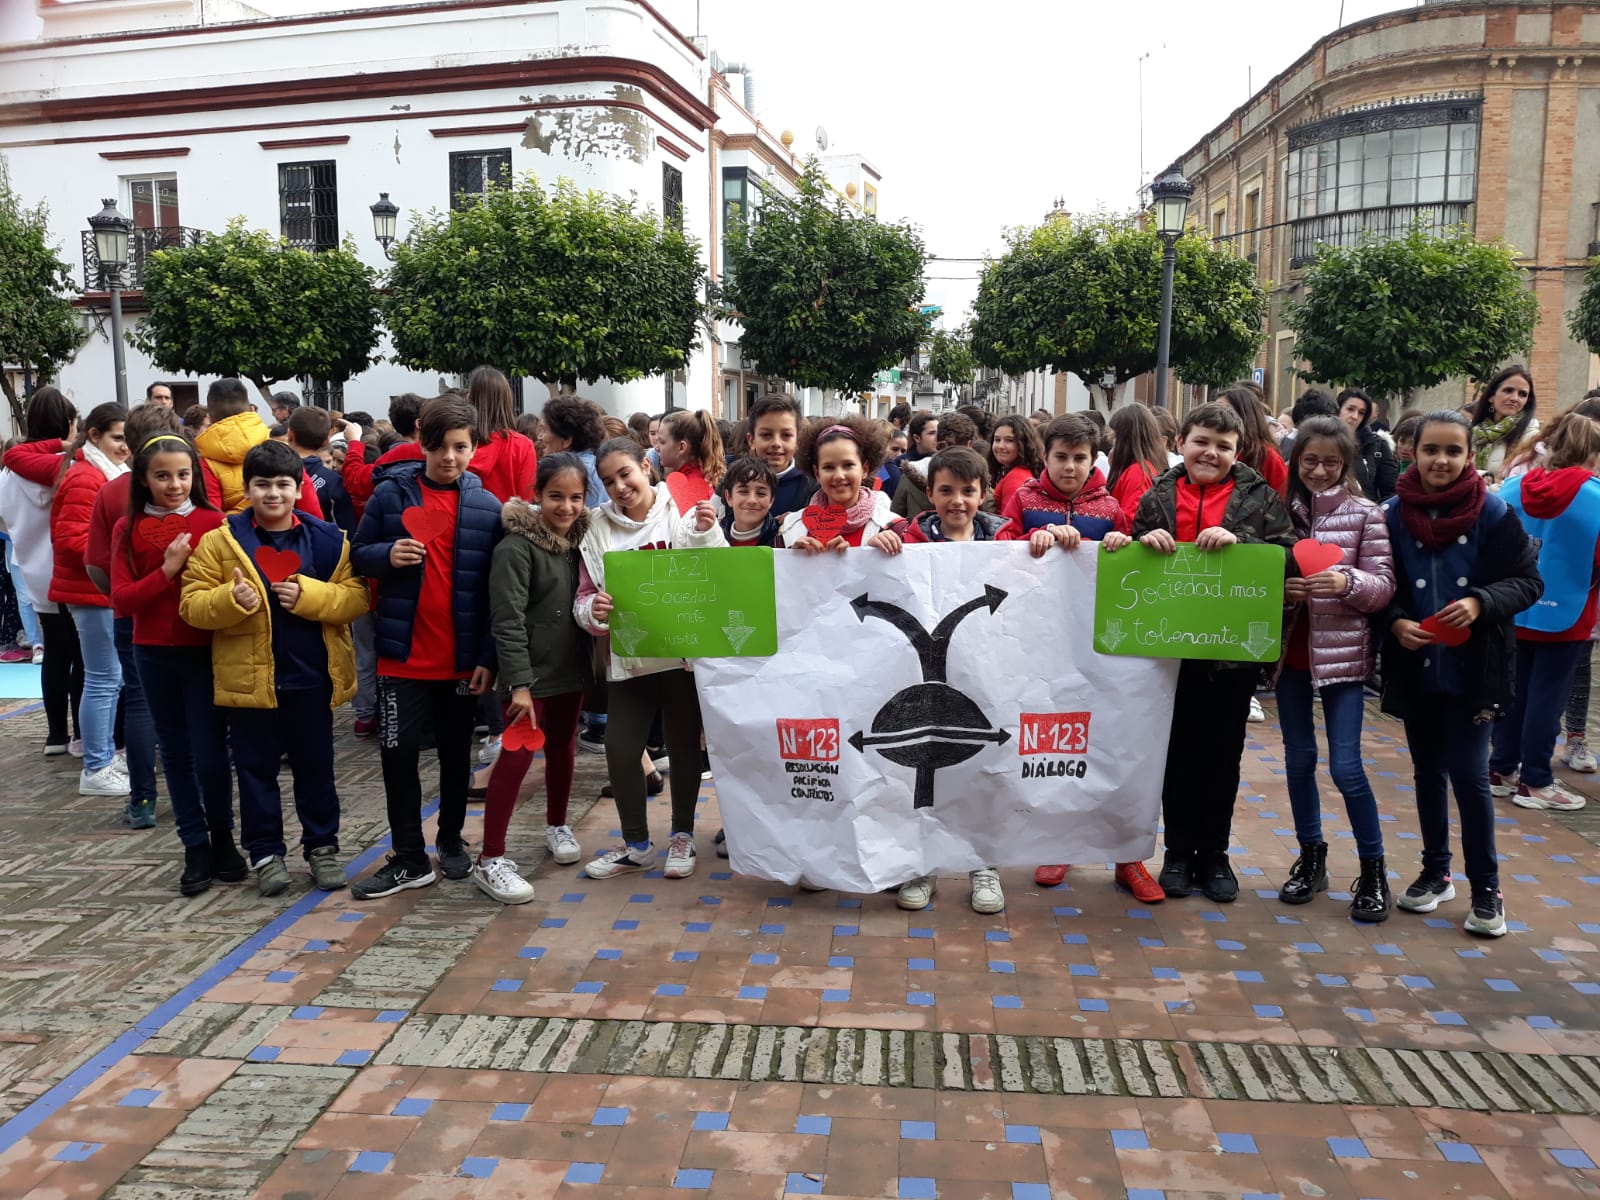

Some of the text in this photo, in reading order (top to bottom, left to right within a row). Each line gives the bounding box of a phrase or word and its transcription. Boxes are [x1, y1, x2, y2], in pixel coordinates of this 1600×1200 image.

[668, 555, 702, 577] A-2
[1171, 545, 1209, 573] A-1
[638, 582, 717, 606] Sociedad
[1115, 570, 1267, 610] Sociedad más
[677, 609, 705, 625] más
[664, 632, 700, 649] justa
[1132, 616, 1240, 646] tolerante
[386, 690, 399, 749] UCTURAS
[781, 727, 838, 758] N-123
[1023, 722, 1087, 751] N-123
[784, 761, 839, 775] RESOLUCIÓN
[1021, 757, 1087, 779] DIÁLOGO
[791, 787, 835, 802] CONFLICTOS
